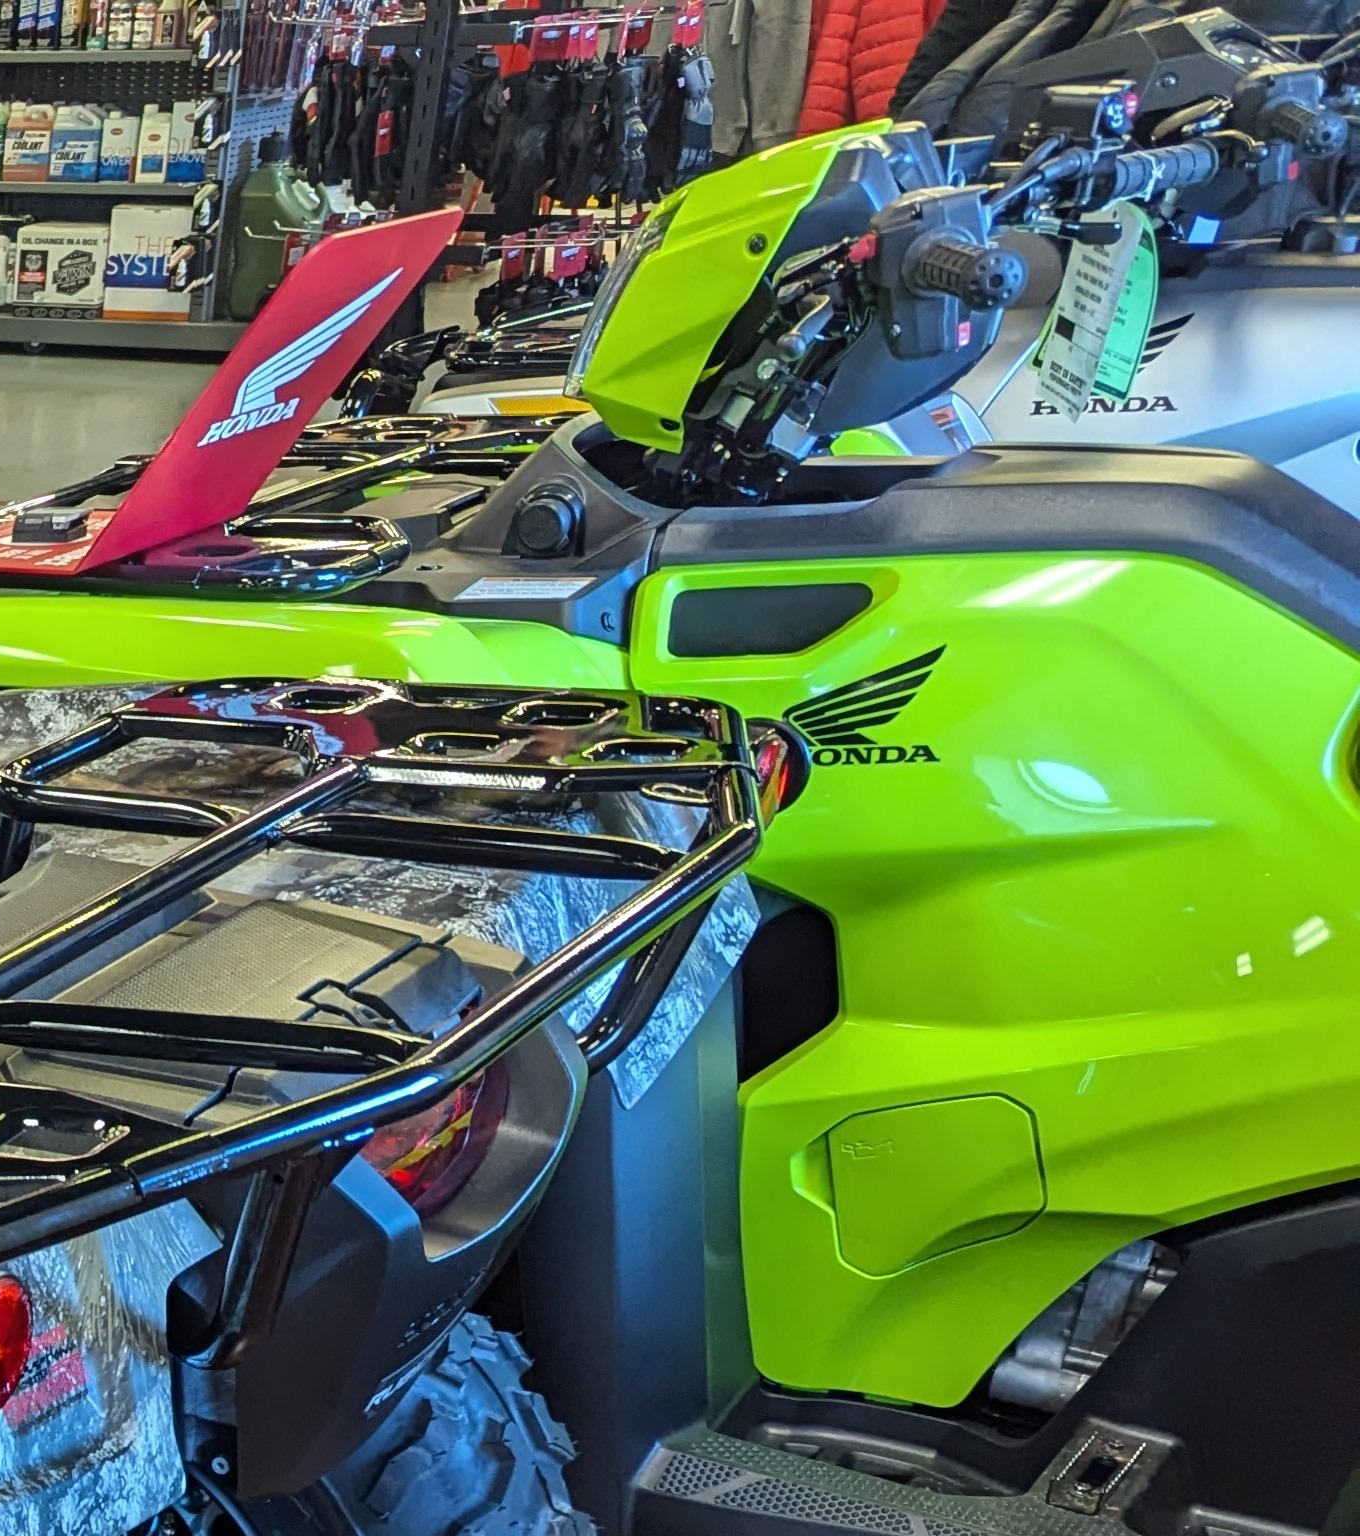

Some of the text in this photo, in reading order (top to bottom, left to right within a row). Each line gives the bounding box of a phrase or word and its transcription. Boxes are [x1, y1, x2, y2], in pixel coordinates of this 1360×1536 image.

[12, 141, 43, 150] COOLANT
[54, 152, 86, 161] COOLANT
[196, 397, 300, 447] HONDA
[809, 745, 940, 766] ONDA
